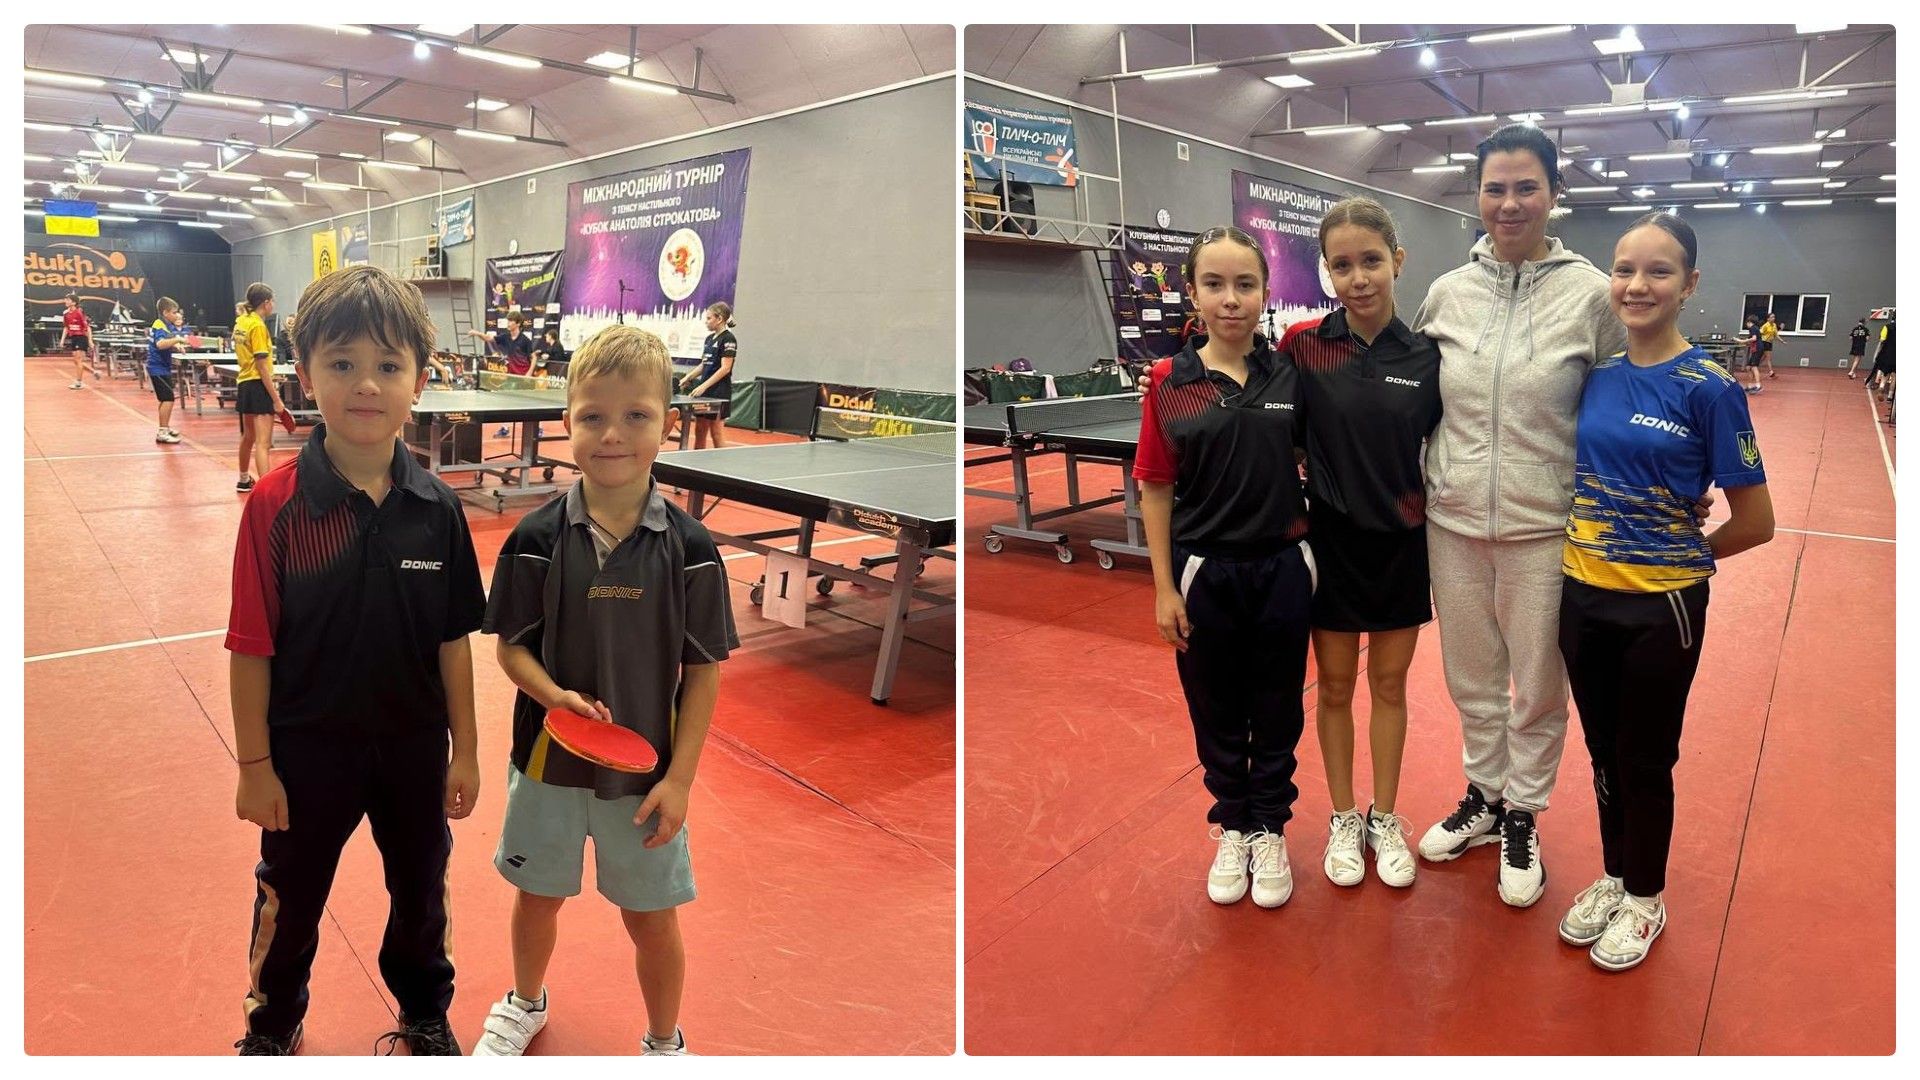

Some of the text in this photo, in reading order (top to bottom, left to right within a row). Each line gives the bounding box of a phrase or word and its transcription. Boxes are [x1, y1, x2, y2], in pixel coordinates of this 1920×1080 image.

[1001, 126, 1067, 147] ПЛІЧ-О-ПЛІЧ
[583, 164, 725, 204] МІЖНАРОДНИЙ ТУРНІР
[1249, 182, 1322, 212] МІЖНАРОДНИЙ
[609, 216, 652, 232] АНАТОЛІЯ
[653, 207, 721, 227] СТРОКАТОВА»
[1129, 230, 1195, 245] КЛУБНИЙ ЧЕМПІОНАТ
[1279, 222, 1311, 237] АНАТОЛІЯ
[1143, 242, 1190, 254] З НАСТІЛЬНОГО
[24, 271, 145, 294] cademy
[1385, 375, 1421, 388] DONIC
[1264, 402, 1295, 411] DONIC
[1629, 412, 1691, 438] DONIC
[853, 508, 886, 522] Didukh
[858, 516, 903, 533] academy
[400, 559, 443, 571] DONIC
[586, 584, 643, 600] DONIC
[777, 570, 791, 600] 1
